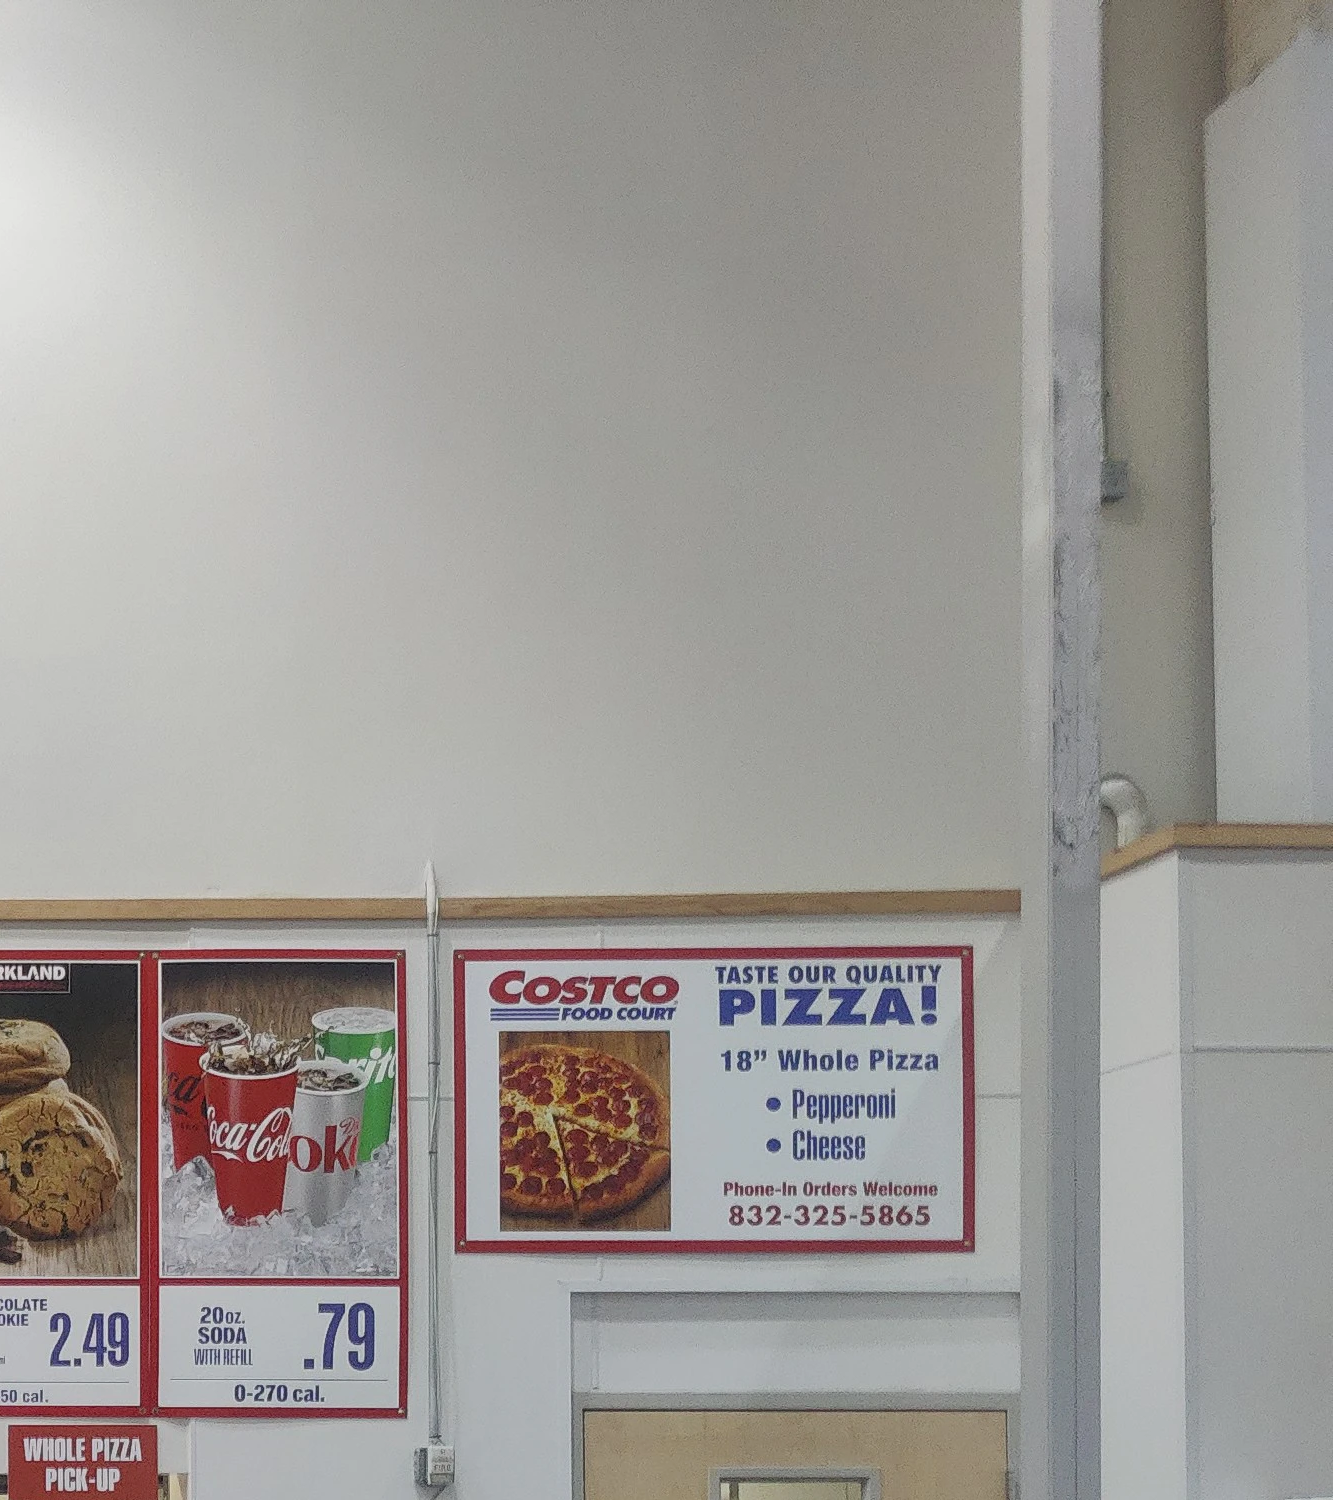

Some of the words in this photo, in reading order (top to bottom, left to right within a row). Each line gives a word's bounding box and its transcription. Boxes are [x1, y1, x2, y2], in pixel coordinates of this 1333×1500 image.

[715, 966, 778, 984] TASTE
[788, 965, 837, 984] OUR
[846, 964, 942, 985] QUALITY
[489, 970, 680, 1007] COSTCO
[560, 1007, 614, 1021] FOOD
[617, 1006, 678, 1021] COURT
[719, 985, 938, 1027] PIZZA!
[778, 1050, 859, 1072] Whole
[870, 1049, 940, 1073] Pizza
[792, 1089, 897, 1125] Pepperoni
[792, 1131, 867, 1161] Cheese
[723, 1182, 797, 1198] Phone-In
[803, 1182, 857, 1198] Orders
[863, 1181, 938, 1198] Welcome
[728, 1205, 931, 1227] 832-325-5865
[200, 1306, 224, 1325] 20
[50, 1312, 130, 1367] 2.49
[198, 1327, 248, 1345] SODA
[304, 1302, 375, 1371] .79
[194, 1348, 221, 1366] WITH
[223, 1348, 253, 1366] REFILL
[22, 1390, 49, 1403] cal.
[234, 1384, 288, 1402] 0-270
[293, 1385, 326, 1402] cal.
[23, 1437, 86, 1462] WHOLE
[91, 1437, 143, 1462] PIZZA
[45, 1468, 121, 1492] PICK-UP
